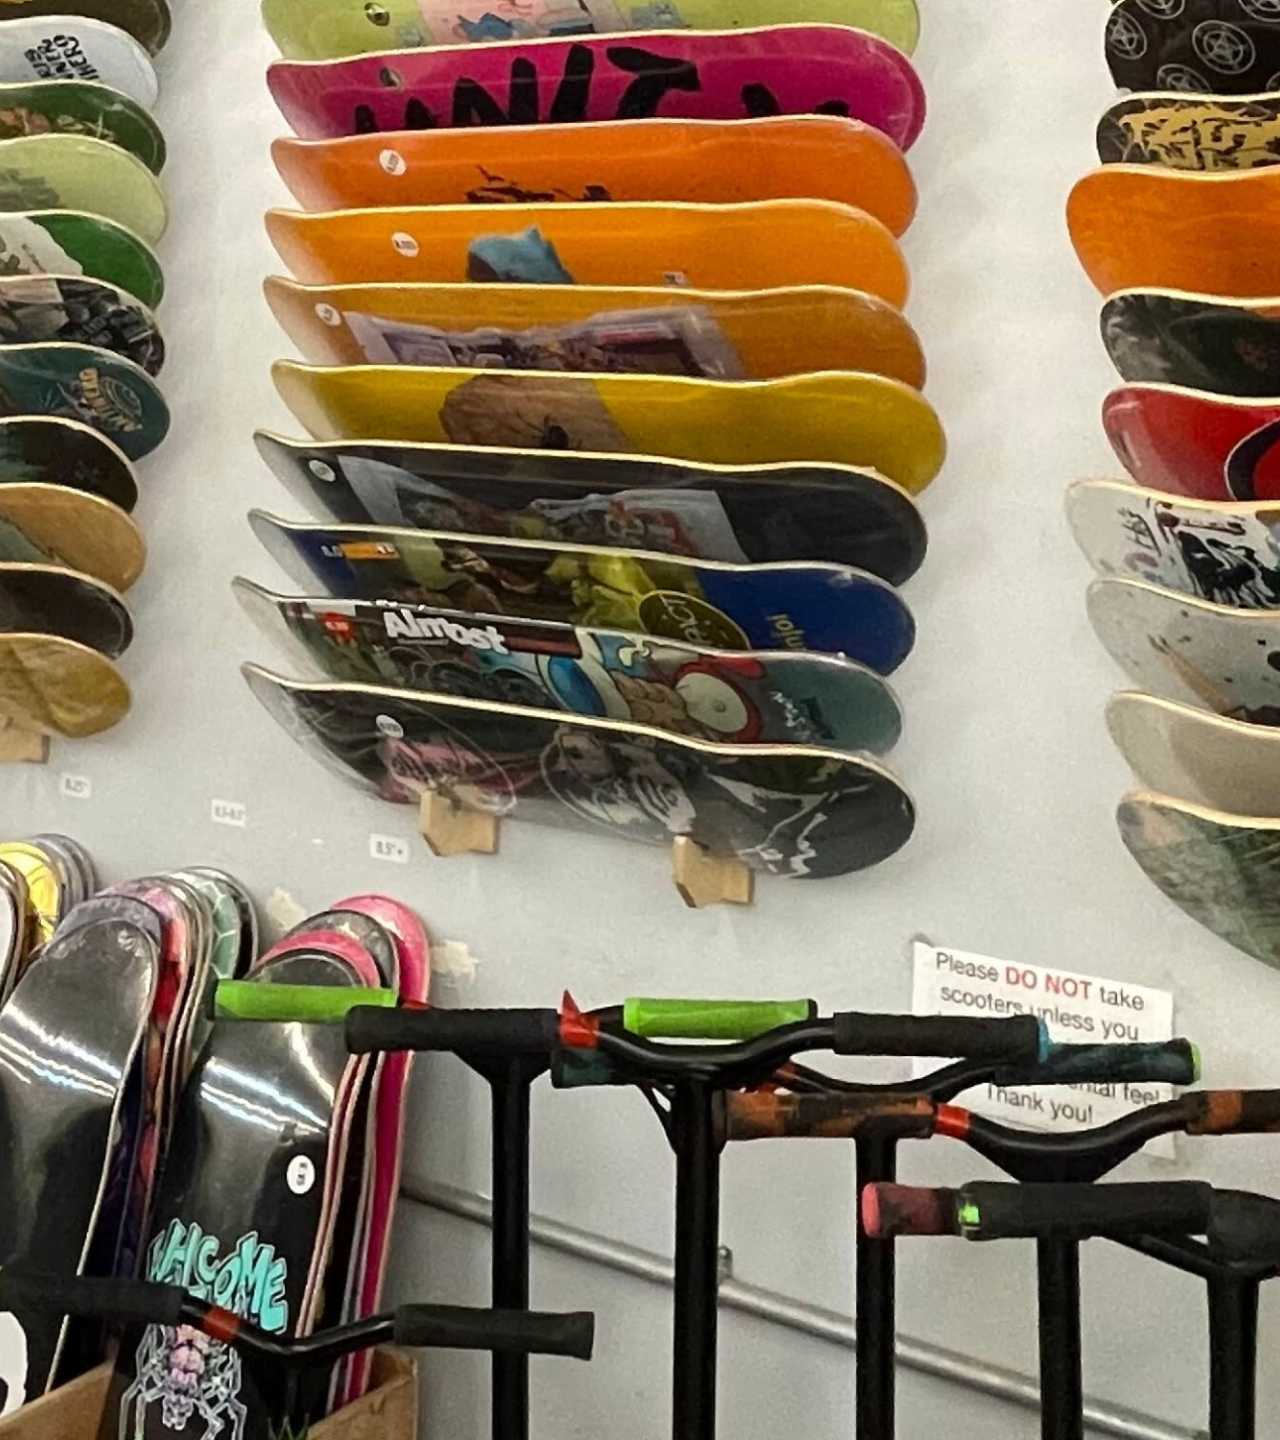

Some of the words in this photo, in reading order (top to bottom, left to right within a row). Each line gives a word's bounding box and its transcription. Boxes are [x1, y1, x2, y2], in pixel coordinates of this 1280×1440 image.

[383, 609, 509, 655] Almost
[935, 951, 999, 982] Please
[1005, 965, 1038, 989] DO
[1045, 973, 1093, 1000] NOT
[1100, 985, 1144, 1011] take
[940, 985, 1024, 1015] scooters
[1101, 1017, 1139, 1042] you
[986, 1084, 1044, 1112] Thank
[1050, 1100, 1094, 1125] you!
